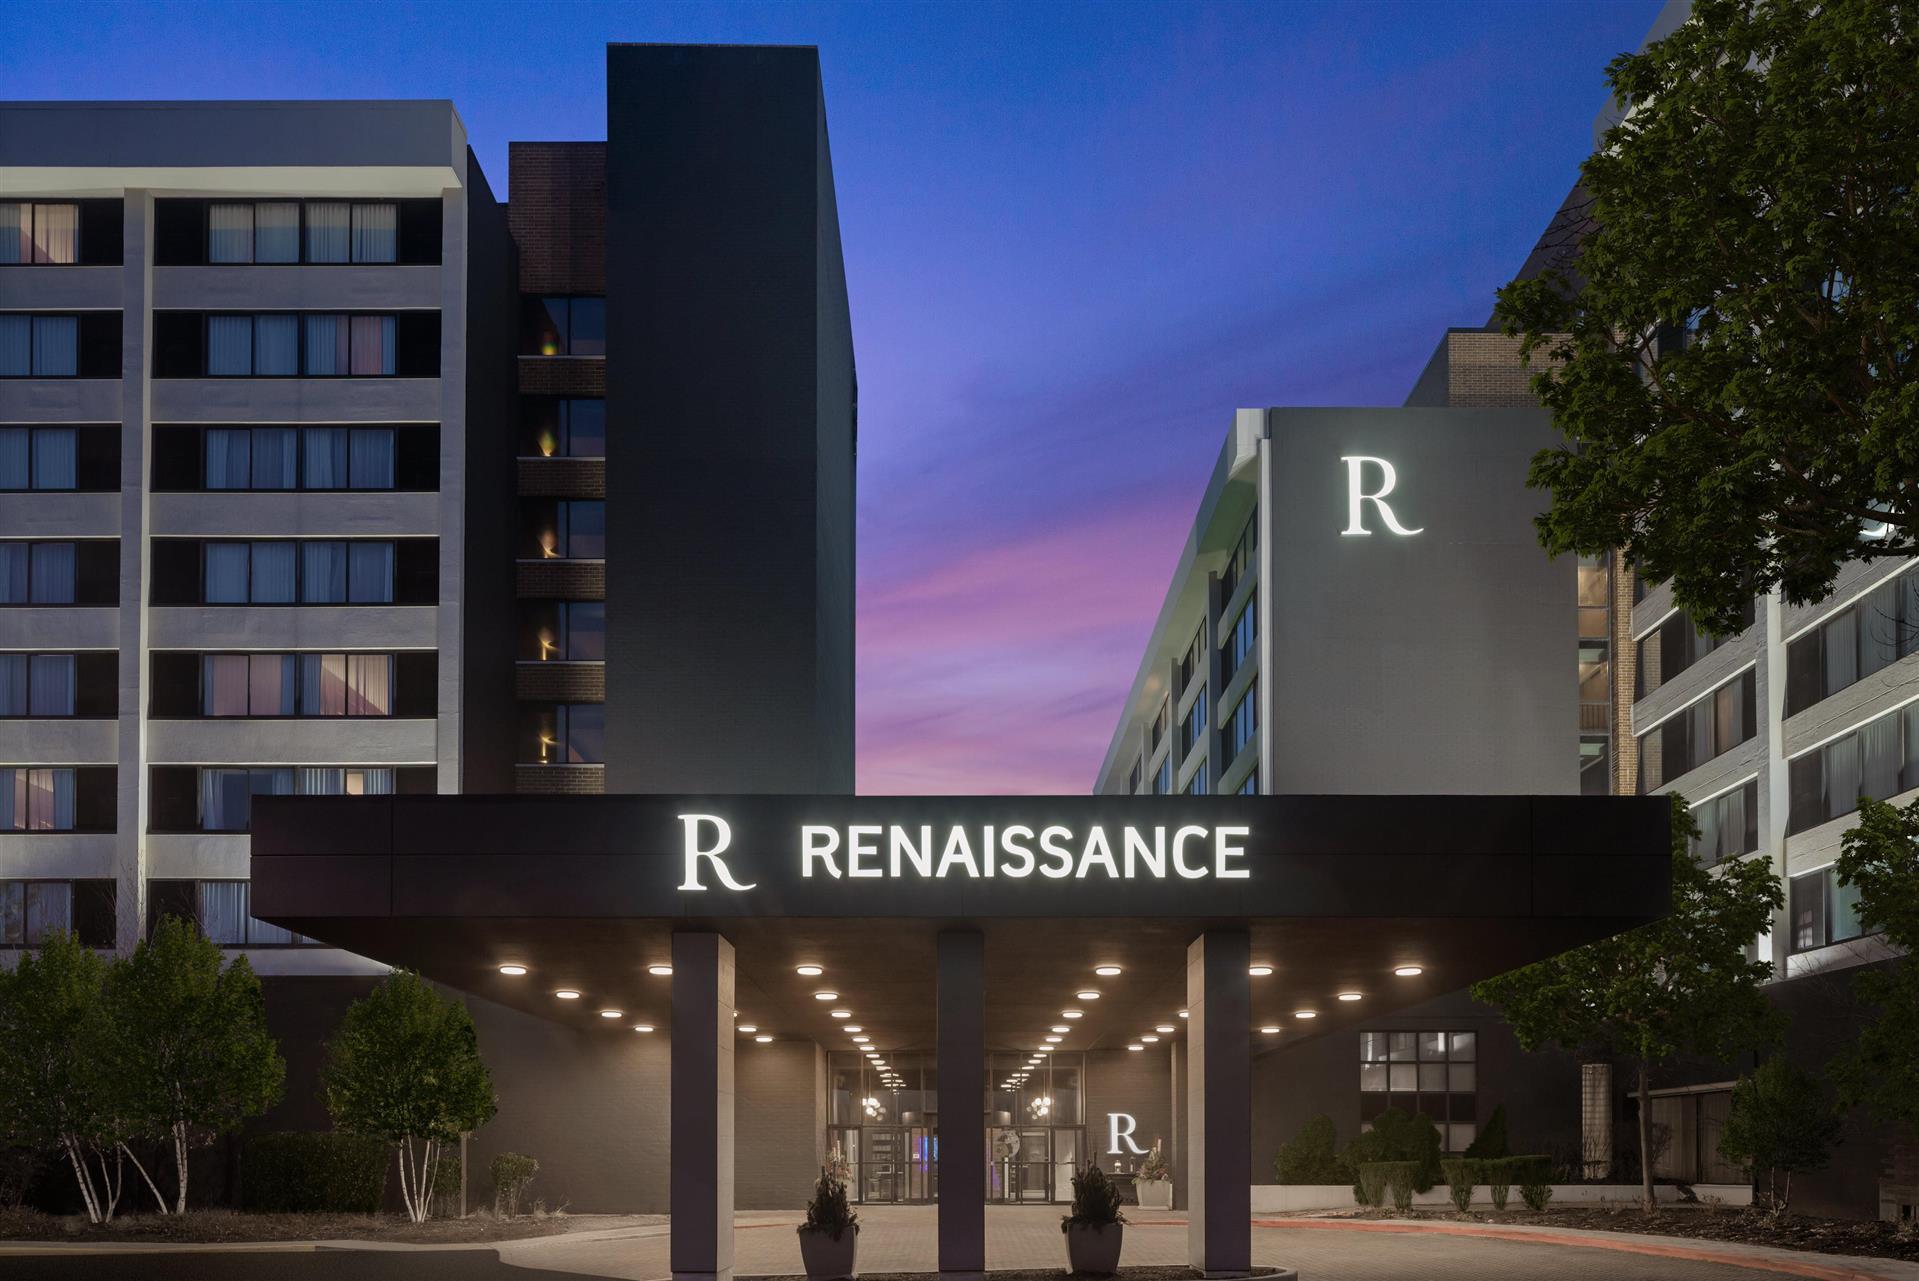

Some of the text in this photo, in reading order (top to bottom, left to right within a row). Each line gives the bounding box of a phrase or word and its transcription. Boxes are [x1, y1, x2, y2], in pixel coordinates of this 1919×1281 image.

[1340, 455, 1424, 536] R
[677, 813, 1251, 891] R RENAISSANCE
[1106, 1112, 1149, 1155] R
